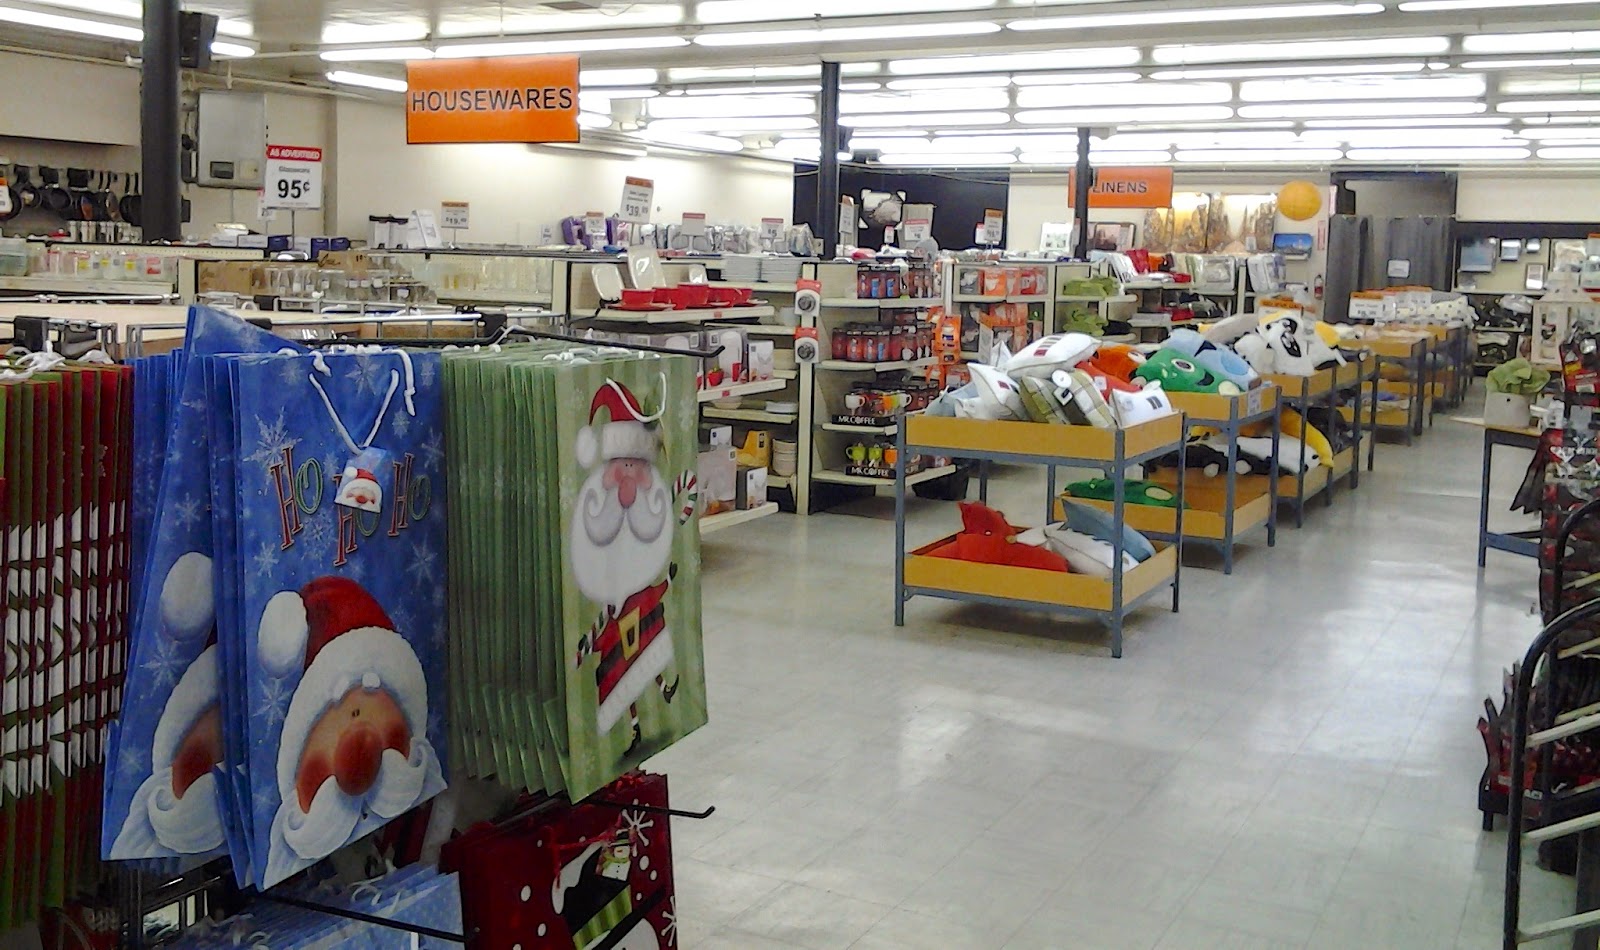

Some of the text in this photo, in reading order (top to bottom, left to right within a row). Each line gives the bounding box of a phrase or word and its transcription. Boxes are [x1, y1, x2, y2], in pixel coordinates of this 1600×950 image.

[412, 87, 573, 112] HOUSEWARES
[1093, 181, 1148, 194] LINENS
[270, 444, 324, 552] HO
[387, 451, 432, 538] HO
